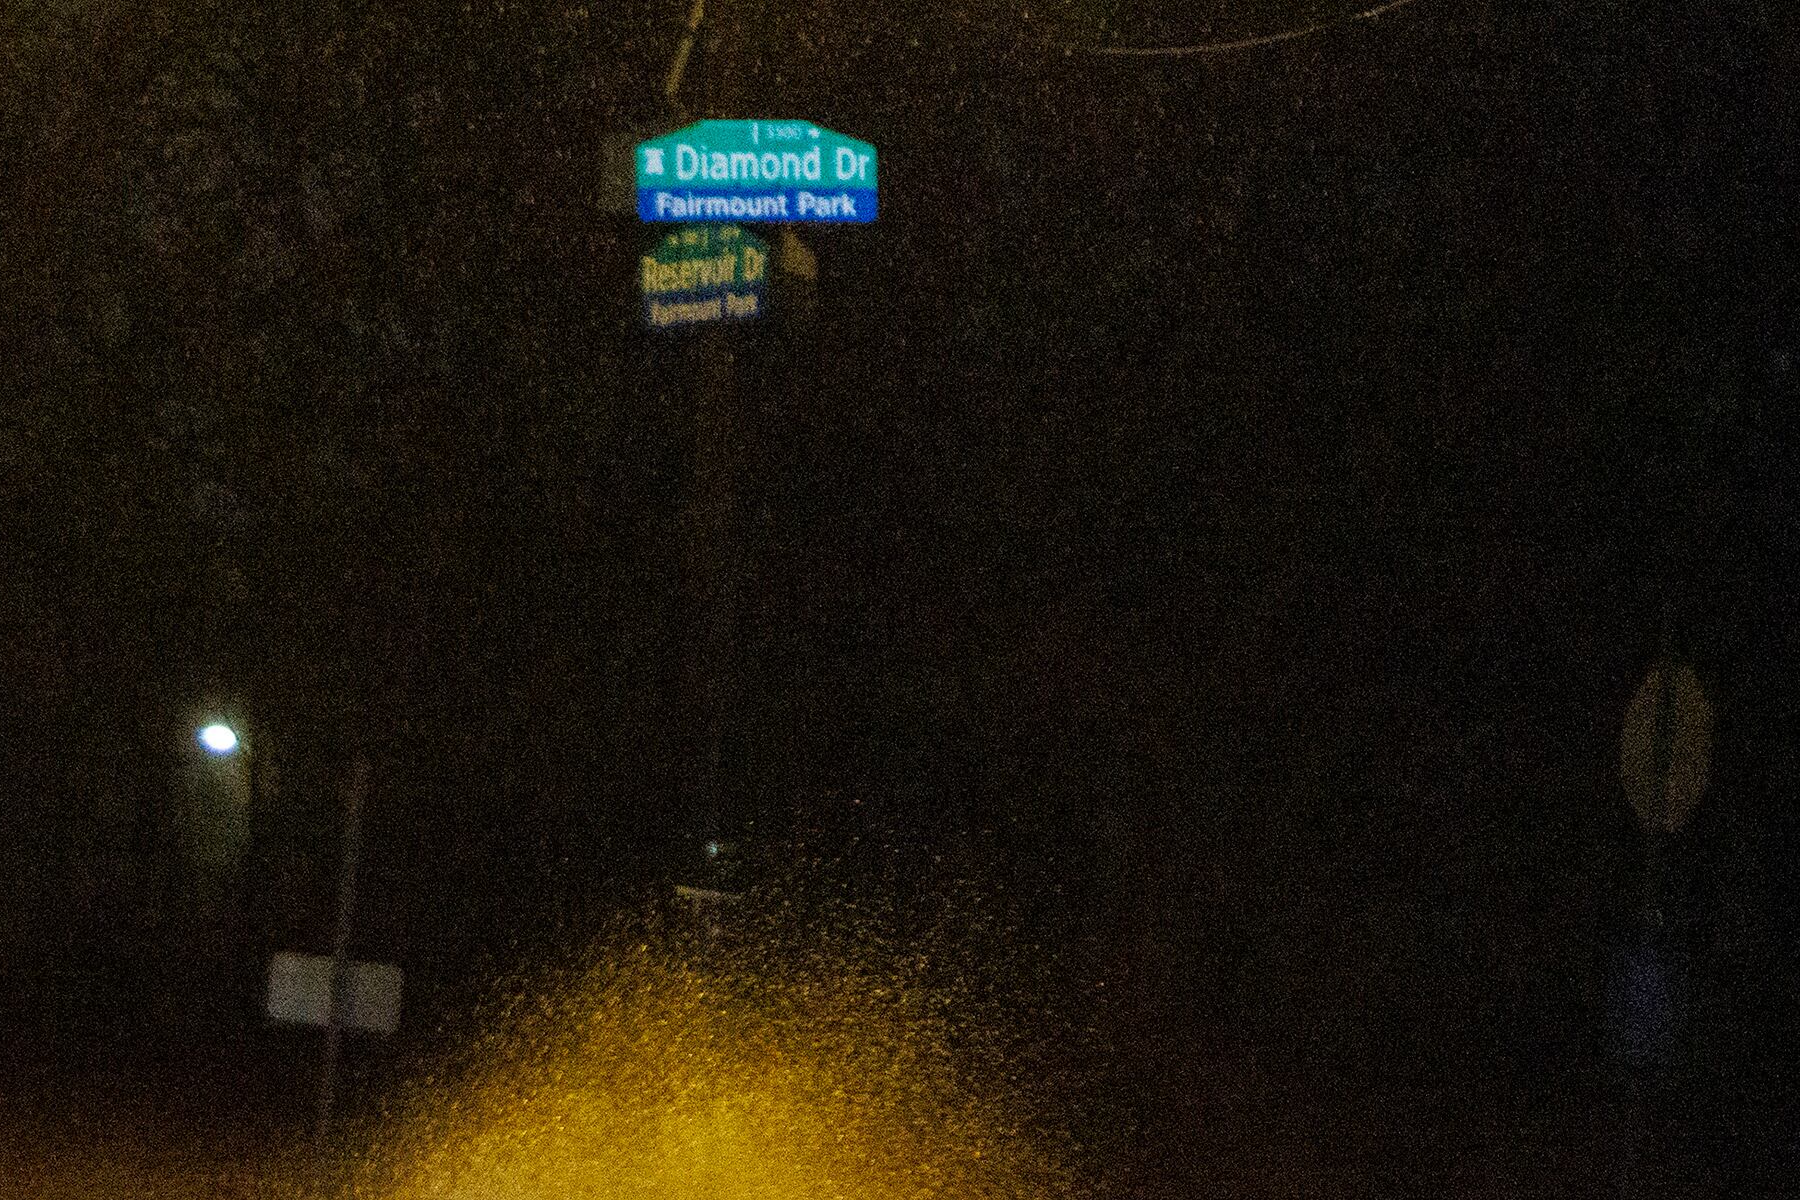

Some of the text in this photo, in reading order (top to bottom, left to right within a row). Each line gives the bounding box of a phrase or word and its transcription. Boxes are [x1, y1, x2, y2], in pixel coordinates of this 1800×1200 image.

[675, 144, 870, 181] Diamond Dr
[656, 192, 857, 217] Fairmount Park
[641, 246, 766, 293] Reservoir Dr
